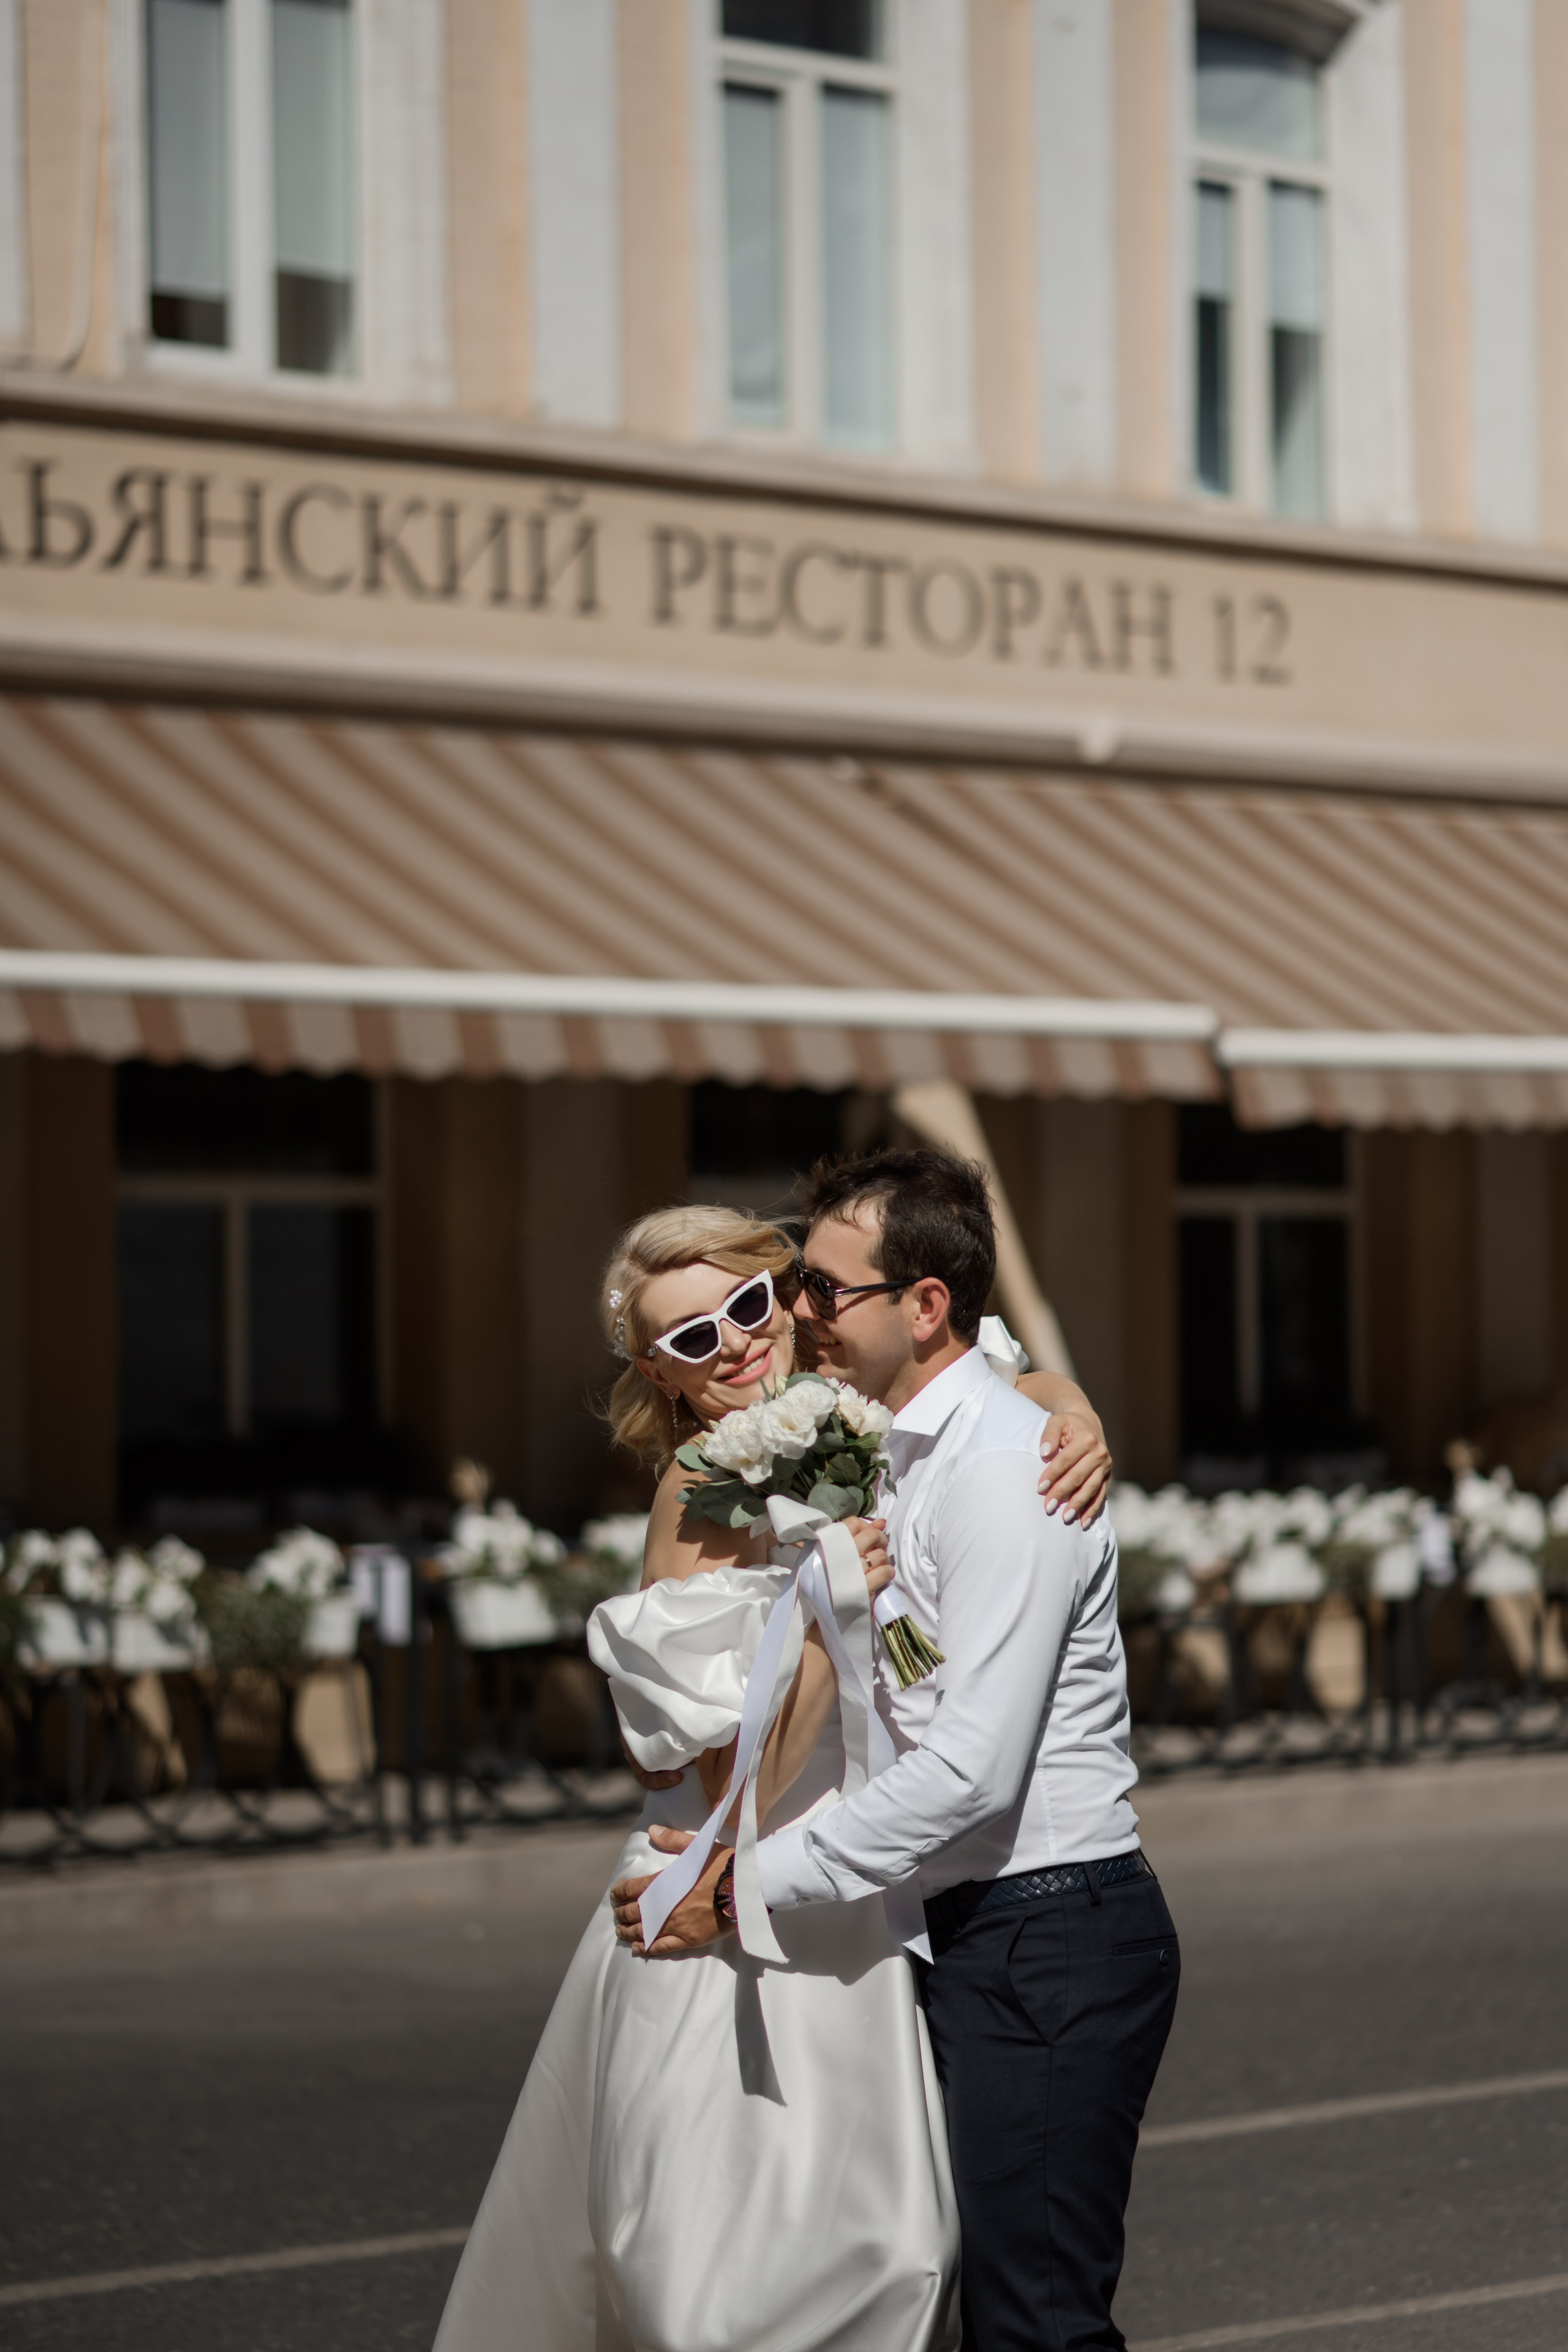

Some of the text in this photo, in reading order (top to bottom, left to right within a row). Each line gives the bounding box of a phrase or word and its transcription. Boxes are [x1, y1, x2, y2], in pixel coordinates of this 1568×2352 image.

[0, 453, 1294, 686] ЬЯНСКИЙ РЕСТОРАН 12
